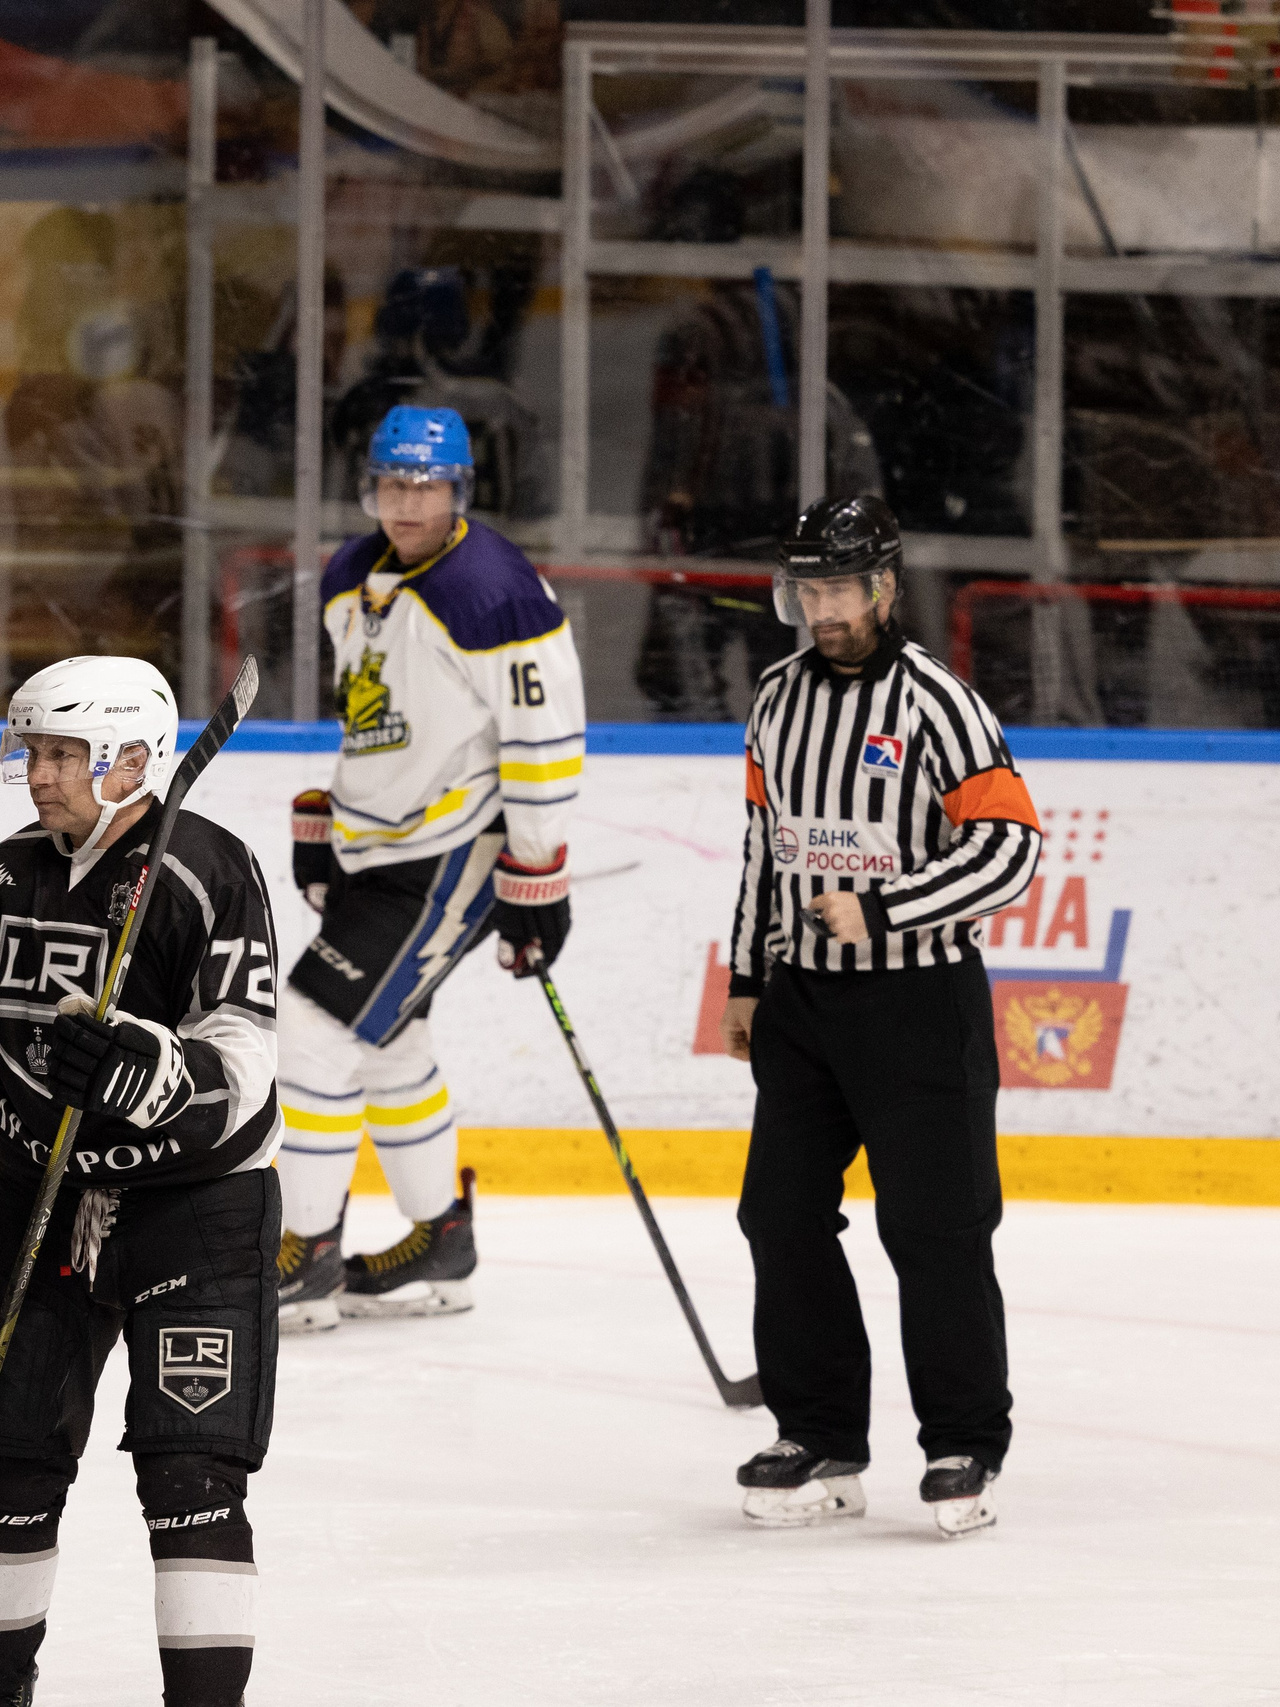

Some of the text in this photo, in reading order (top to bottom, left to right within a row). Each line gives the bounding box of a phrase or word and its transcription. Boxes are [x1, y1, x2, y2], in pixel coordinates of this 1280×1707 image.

[510, 661, 545, 707] 16
[104, 705, 140, 714] BAUER
[808, 828, 860, 849] БАНК
[806, 852, 895, 873] РОССИЯ
[131, 866, 149, 908] CCM
[0, 936, 93, 998] LR
[210, 937, 276, 1008] 72
[134, 1274, 187, 1304] CCM
[165, 1337, 226, 1364] LR
[148, 1507, 231, 1530] BAUER
